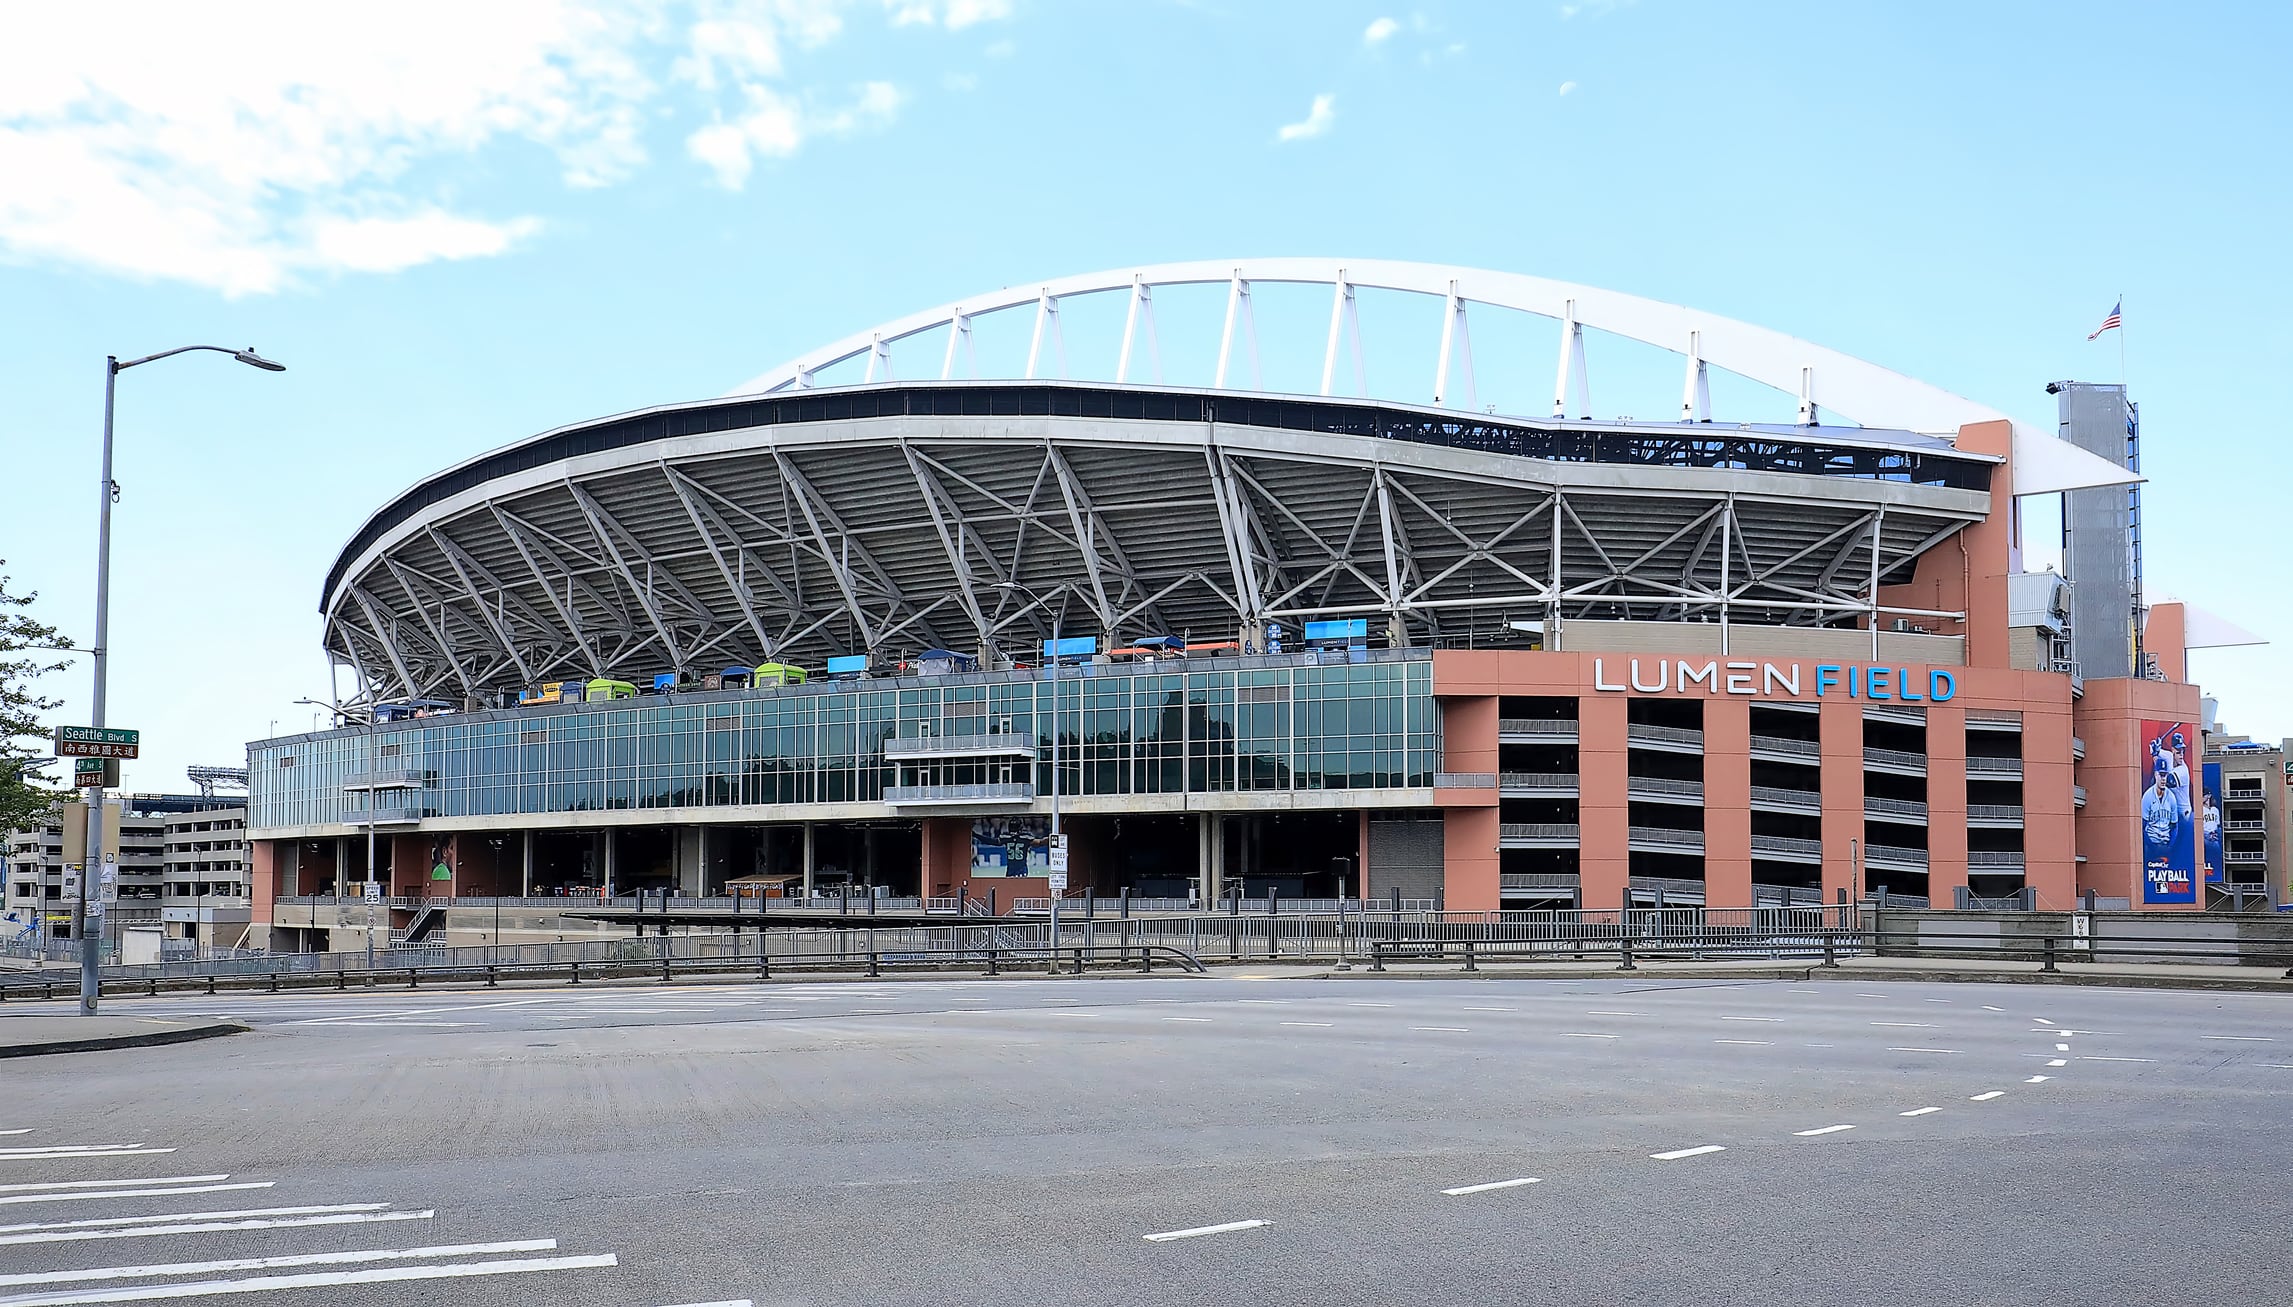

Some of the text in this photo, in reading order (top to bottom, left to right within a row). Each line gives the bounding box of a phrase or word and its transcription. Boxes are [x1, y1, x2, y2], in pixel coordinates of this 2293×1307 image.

[1594, 658, 1957, 702] LUMEN FIELD
[65, 728, 137, 742] Seattle Blvd S
[2169, 882, 2190, 893] PARK
[366, 894, 379, 902] 25
